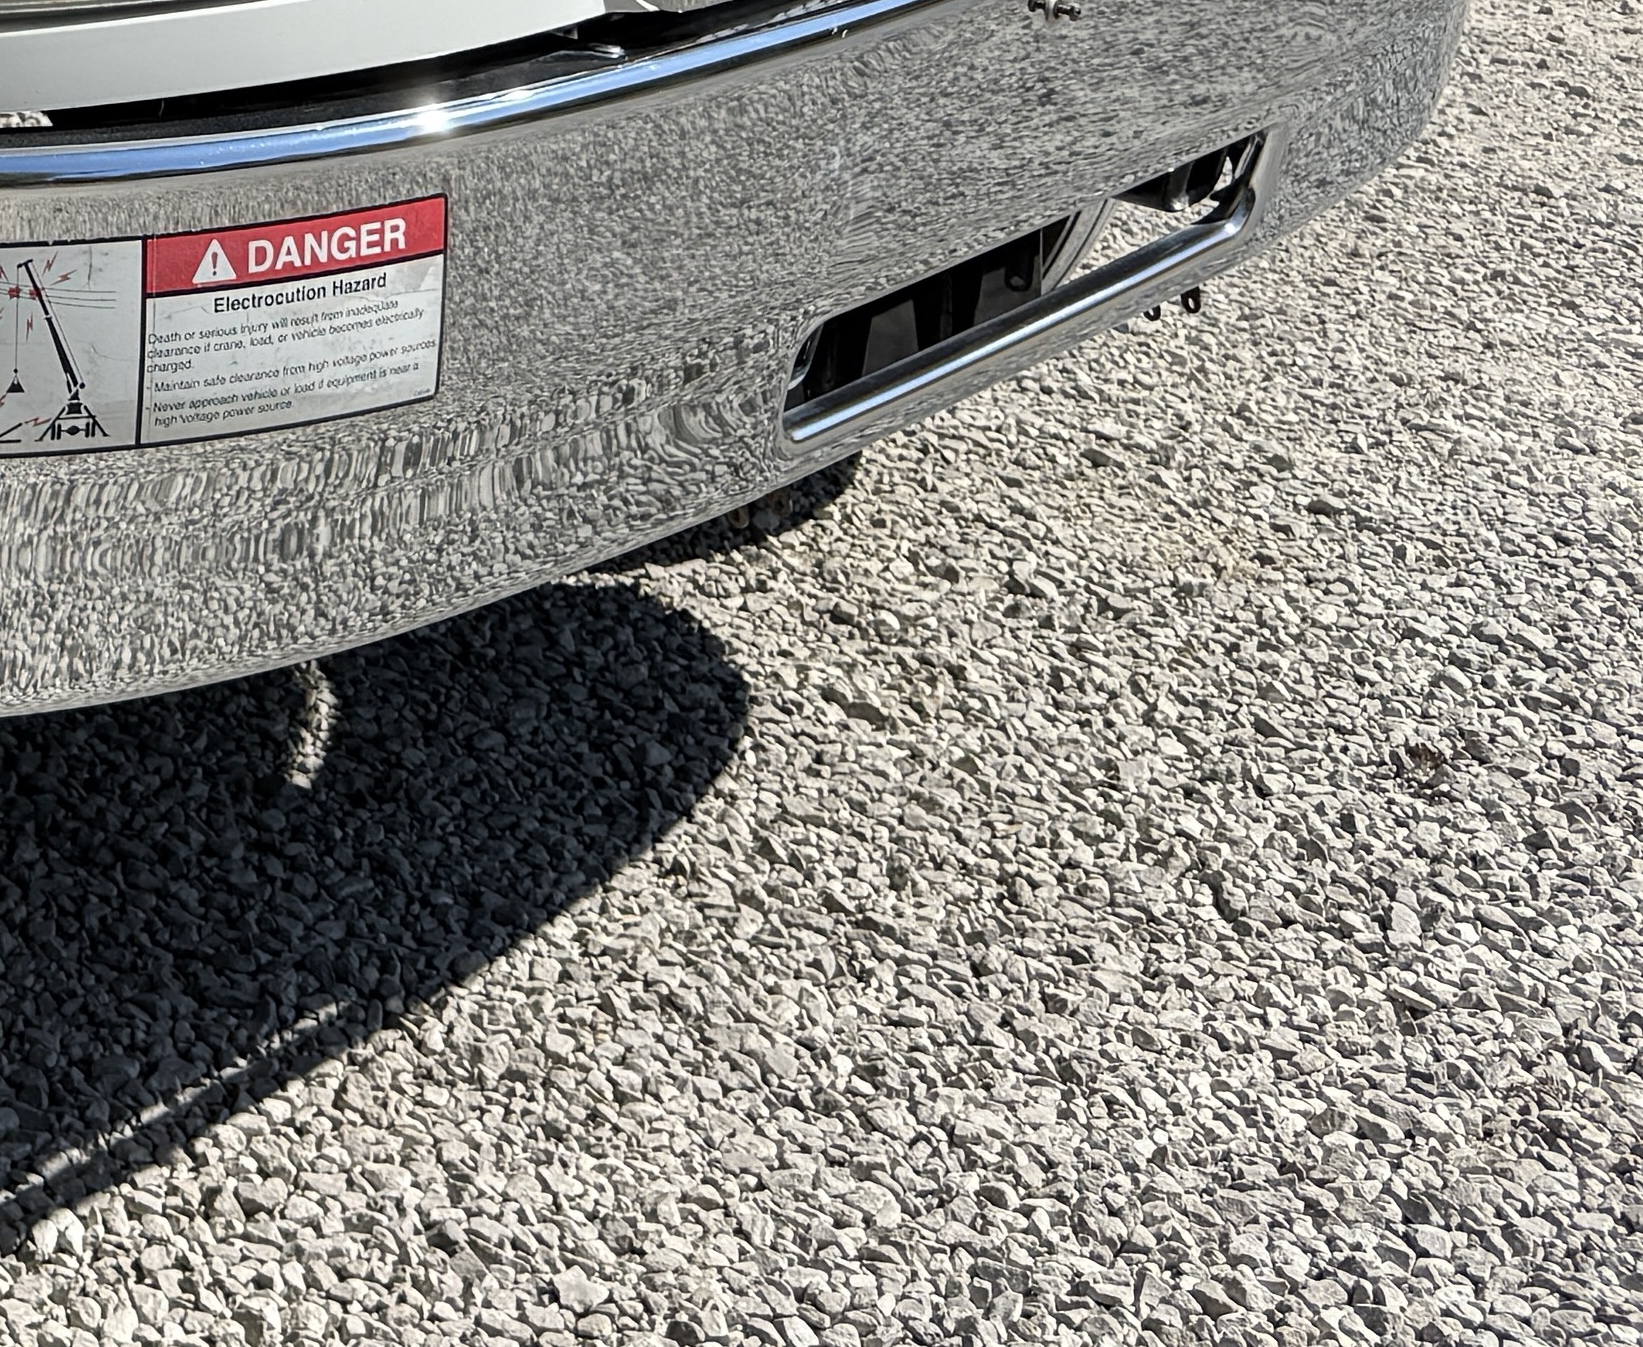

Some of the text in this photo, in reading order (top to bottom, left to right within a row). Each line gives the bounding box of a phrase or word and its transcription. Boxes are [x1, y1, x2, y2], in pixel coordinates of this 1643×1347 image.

[247, 217, 407, 274] DANGER
[214, 272, 387, 314] Electrocution Hazard
[146, 345, 201, 359] clearance
[277, 333, 288, 343] or
[291, 326, 327, 341] vehicle
[328, 318, 374, 334] becomes
[148, 333, 181, 345] Death
[198, 326, 237, 339] serious
[271, 317, 288, 329] will
[290, 312, 319, 326] result
[321, 310, 343, 323] from
[153, 401, 187, 413] Never
[188, 393, 239, 410] approach
[241, 387, 278, 402] vehicle
[280, 386, 291, 397] or
[293, 381, 316, 394] load
[326, 370, 377, 388] equipment
[378, 367, 387, 378] is
[389, 363, 411, 375] near
[412, 362, 420, 371] a
[154, 380, 201, 393] Maintain
[203, 375, 226, 387] safe
[229, 368, 280, 384] clearance
[282, 364, 306, 378] from
[309, 359, 329, 374] high
[332, 354, 367, 367] voltage
[368, 347, 399, 363] power
[154, 414, 178, 428] high
[179, 411, 220, 424] voltage
[222, 405, 255, 421] power
